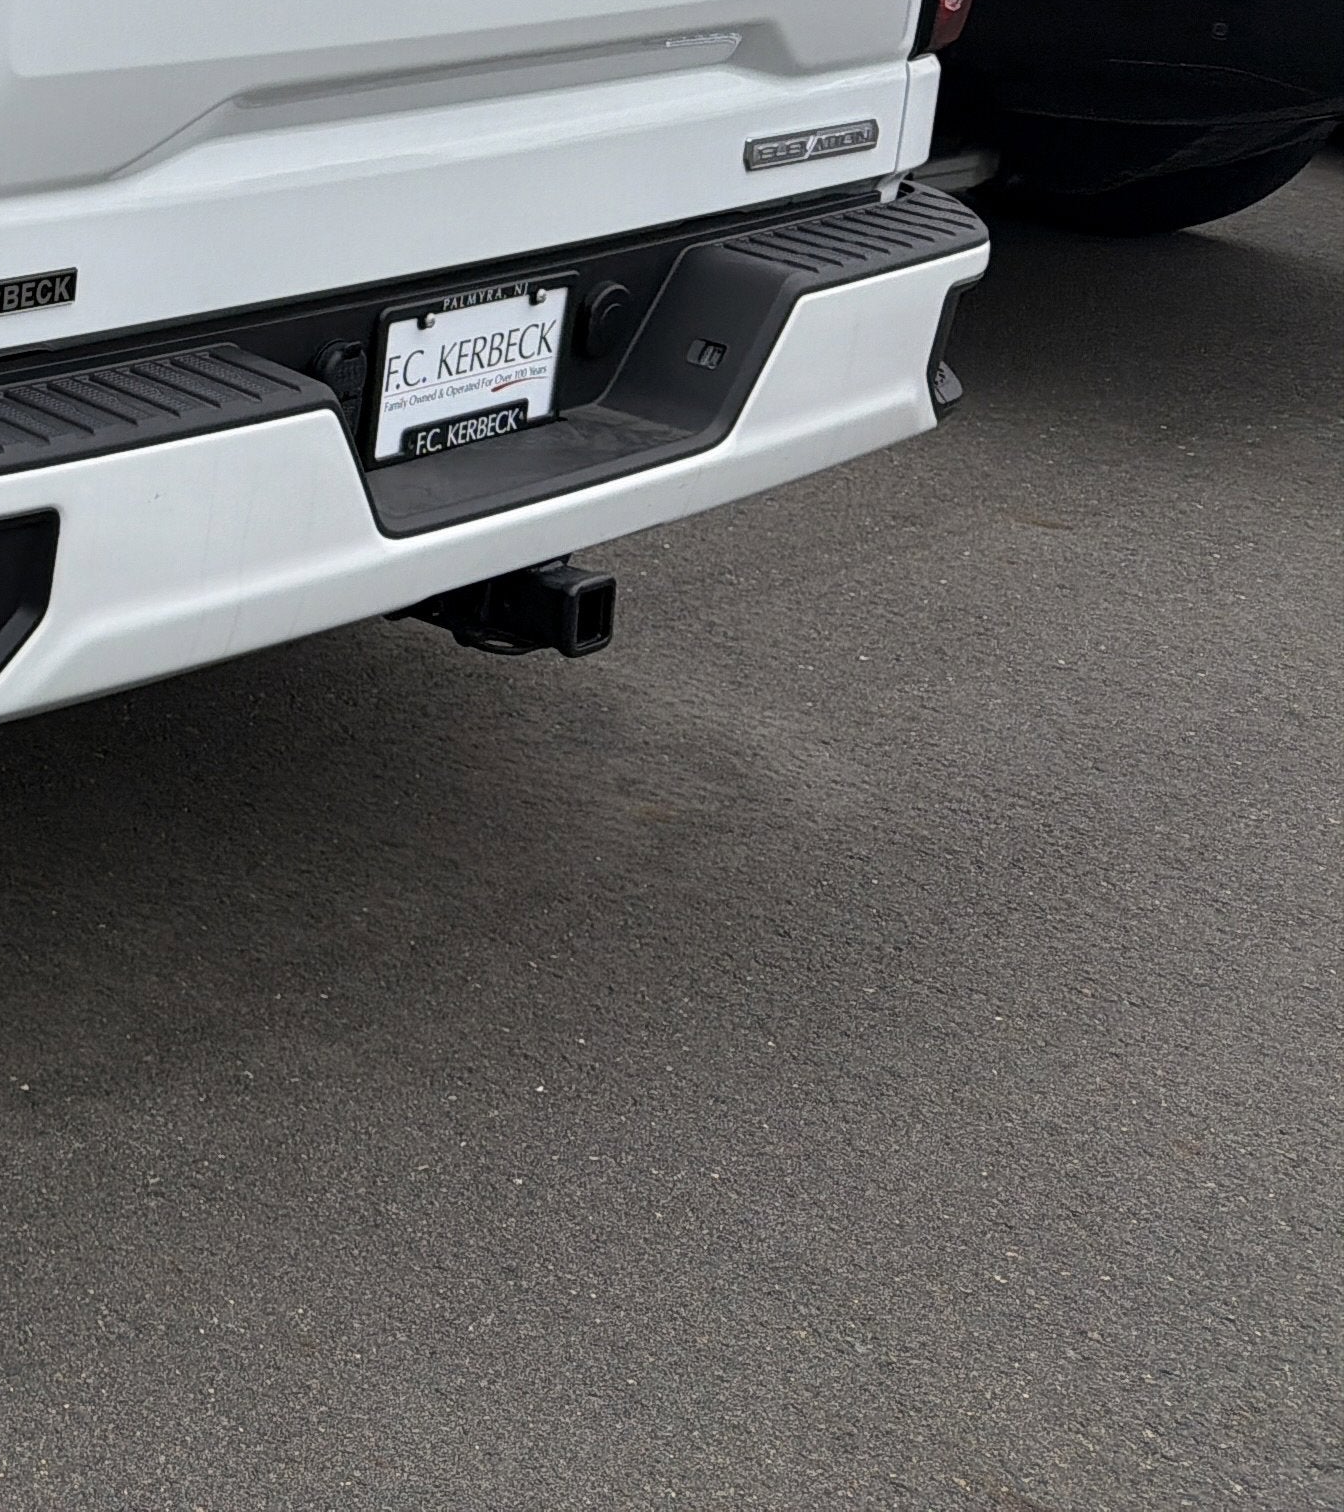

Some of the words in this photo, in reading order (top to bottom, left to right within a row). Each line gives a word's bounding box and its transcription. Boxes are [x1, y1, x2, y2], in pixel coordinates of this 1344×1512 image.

[514, 282, 528, 296] NJ
[385, 349, 427, 393] F.C.
[436, 319, 557, 380] KERBECK
[384, 398, 408, 413] Family
[409, 391, 437, 406] Owned
[438, 388, 444, 400] &
[445, 380, 480, 398] Operated
[481, 376, 493, 388] For
[495, 371, 513, 385] Over
[514, 368, 527, 380] 100
[528, 364, 547, 378] Years
[415, 430, 443, 456] F.C.
[447, 407, 520, 448] KERBECK
